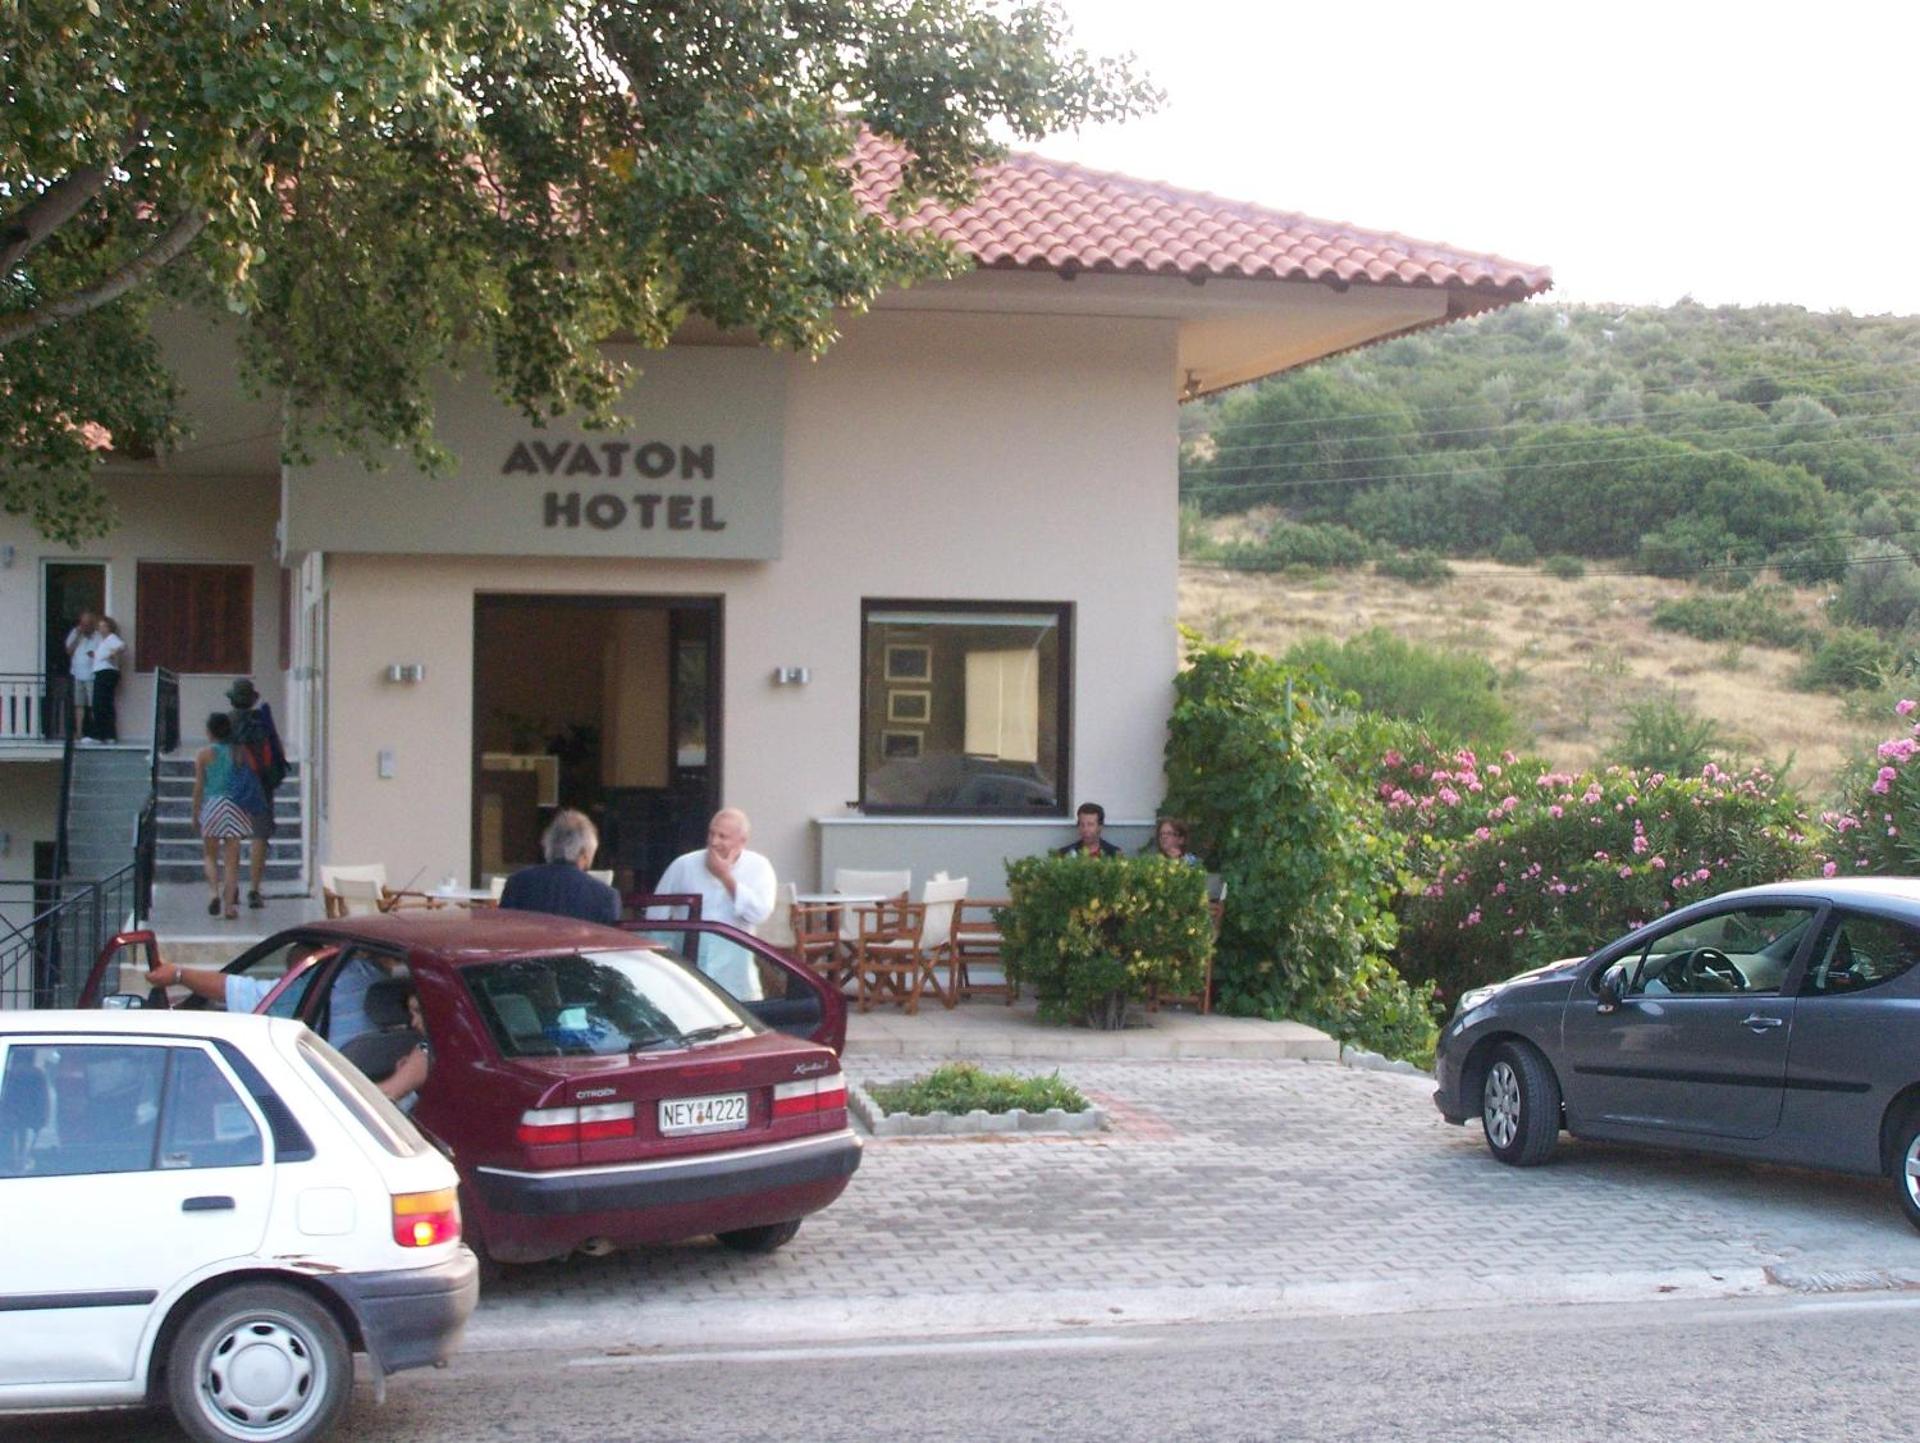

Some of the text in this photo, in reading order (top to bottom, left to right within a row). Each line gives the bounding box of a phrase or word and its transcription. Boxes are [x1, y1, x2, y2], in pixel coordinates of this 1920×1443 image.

[501, 440, 715, 480] AVATON
[544, 491, 727, 532] HOTEL
[664, 1097, 745, 1127] NEY 4222
